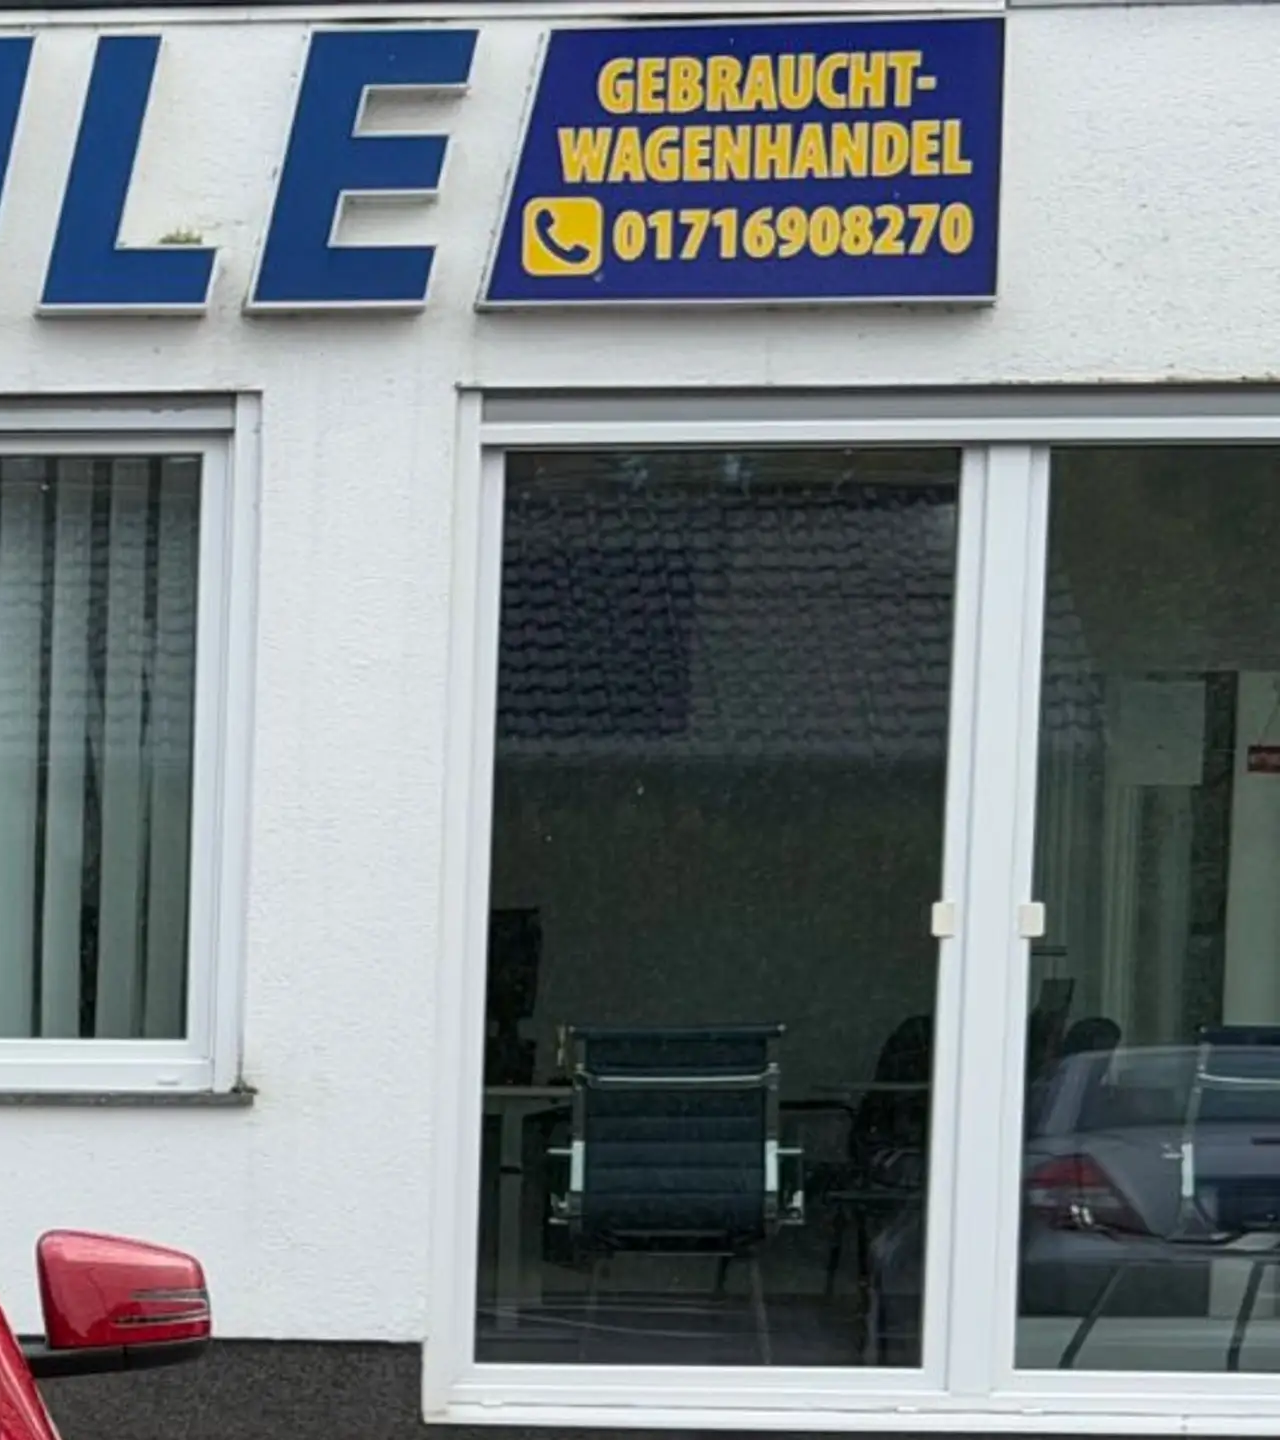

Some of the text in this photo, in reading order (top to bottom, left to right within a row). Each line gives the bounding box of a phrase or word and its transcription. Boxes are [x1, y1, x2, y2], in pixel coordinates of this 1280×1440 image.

[597, 51, 937, 114] GEBRAUCHT-
[558, 119, 973, 183] WAGENHANDEL
[612, 202, 974, 261] 01716908270
